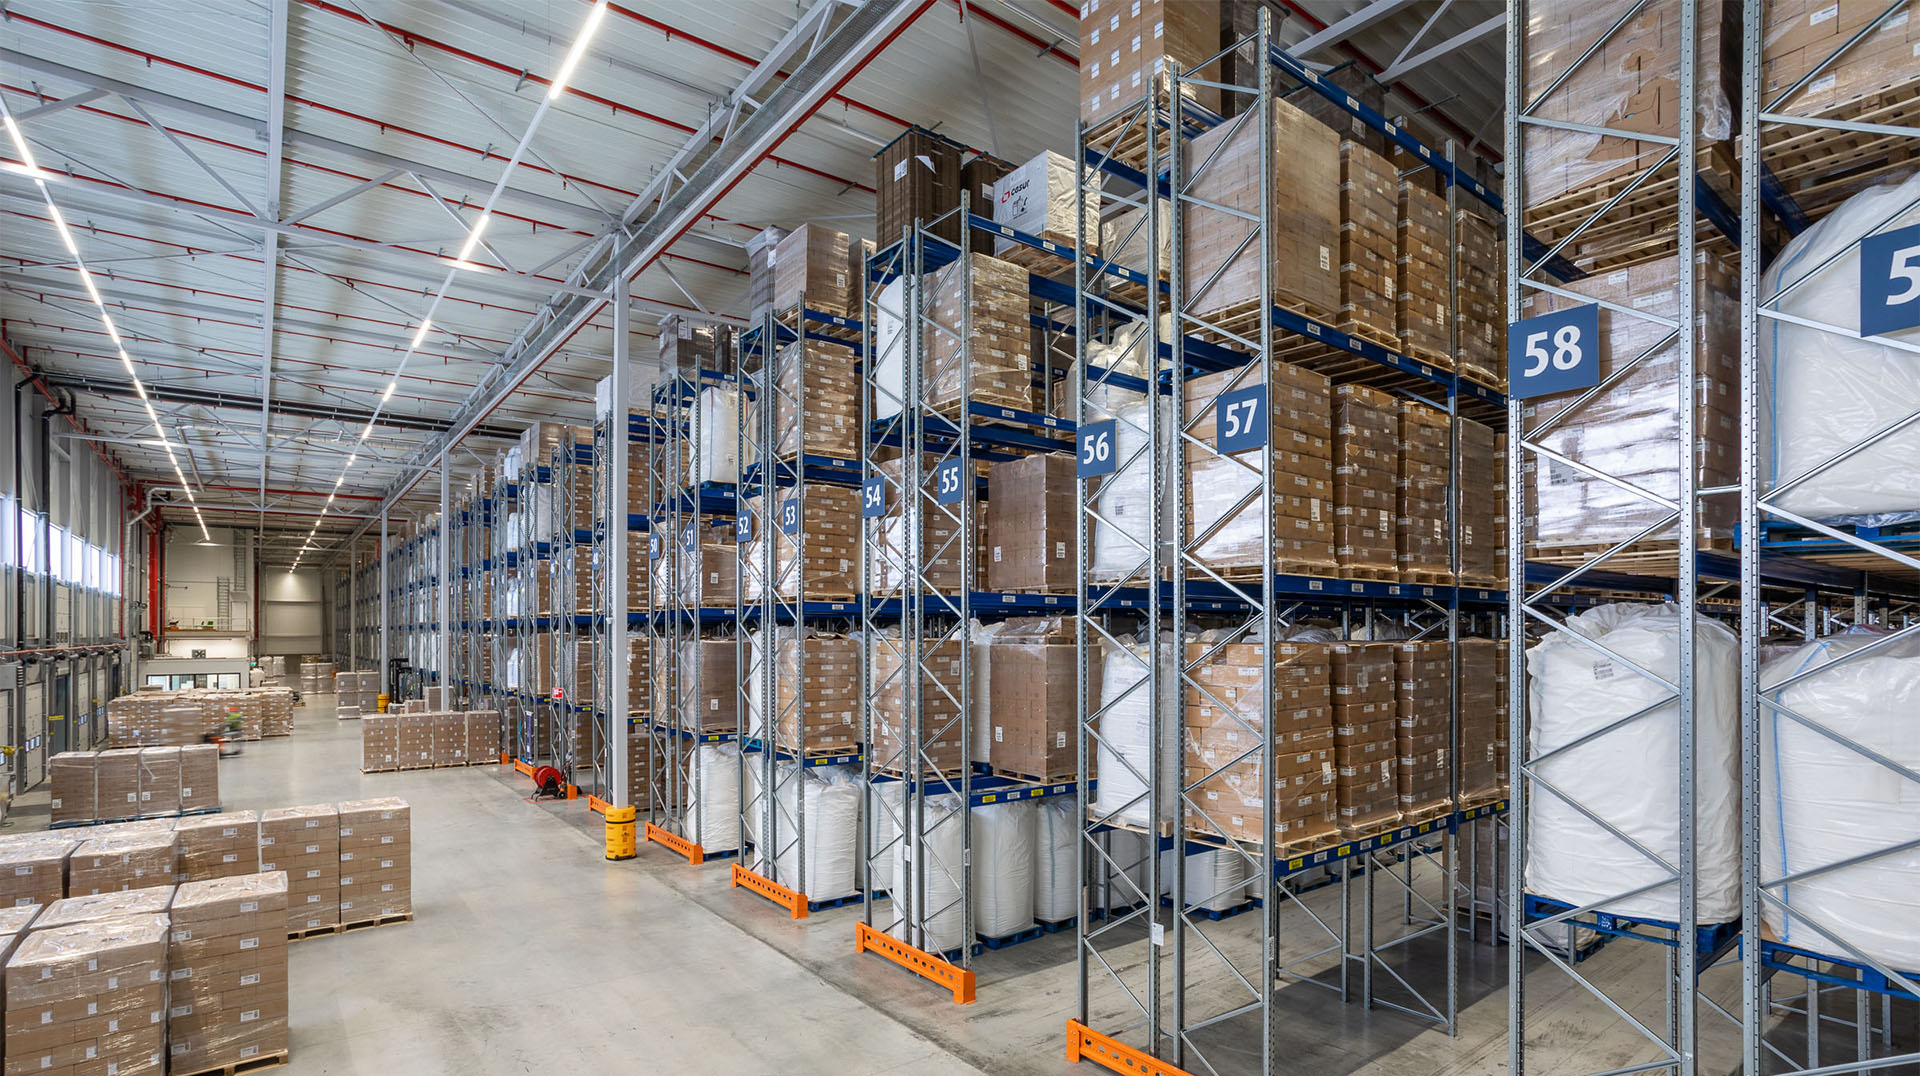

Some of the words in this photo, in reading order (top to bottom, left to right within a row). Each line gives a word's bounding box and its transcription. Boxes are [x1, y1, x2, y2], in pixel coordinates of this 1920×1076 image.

[1885, 244, 1920, 305] 5
[1523, 325, 1583, 378] 58
[1225, 398, 1258, 438] 57
[1083, 431, 1109, 465] 56
[942, 466, 959, 494] 55
[866, 484, 881, 509] 54
[738, 516, 749, 535] 52
[785, 505, 796, 526] 53
[650, 538, 658, 553] 50
[686, 529, 694, 546] 51
